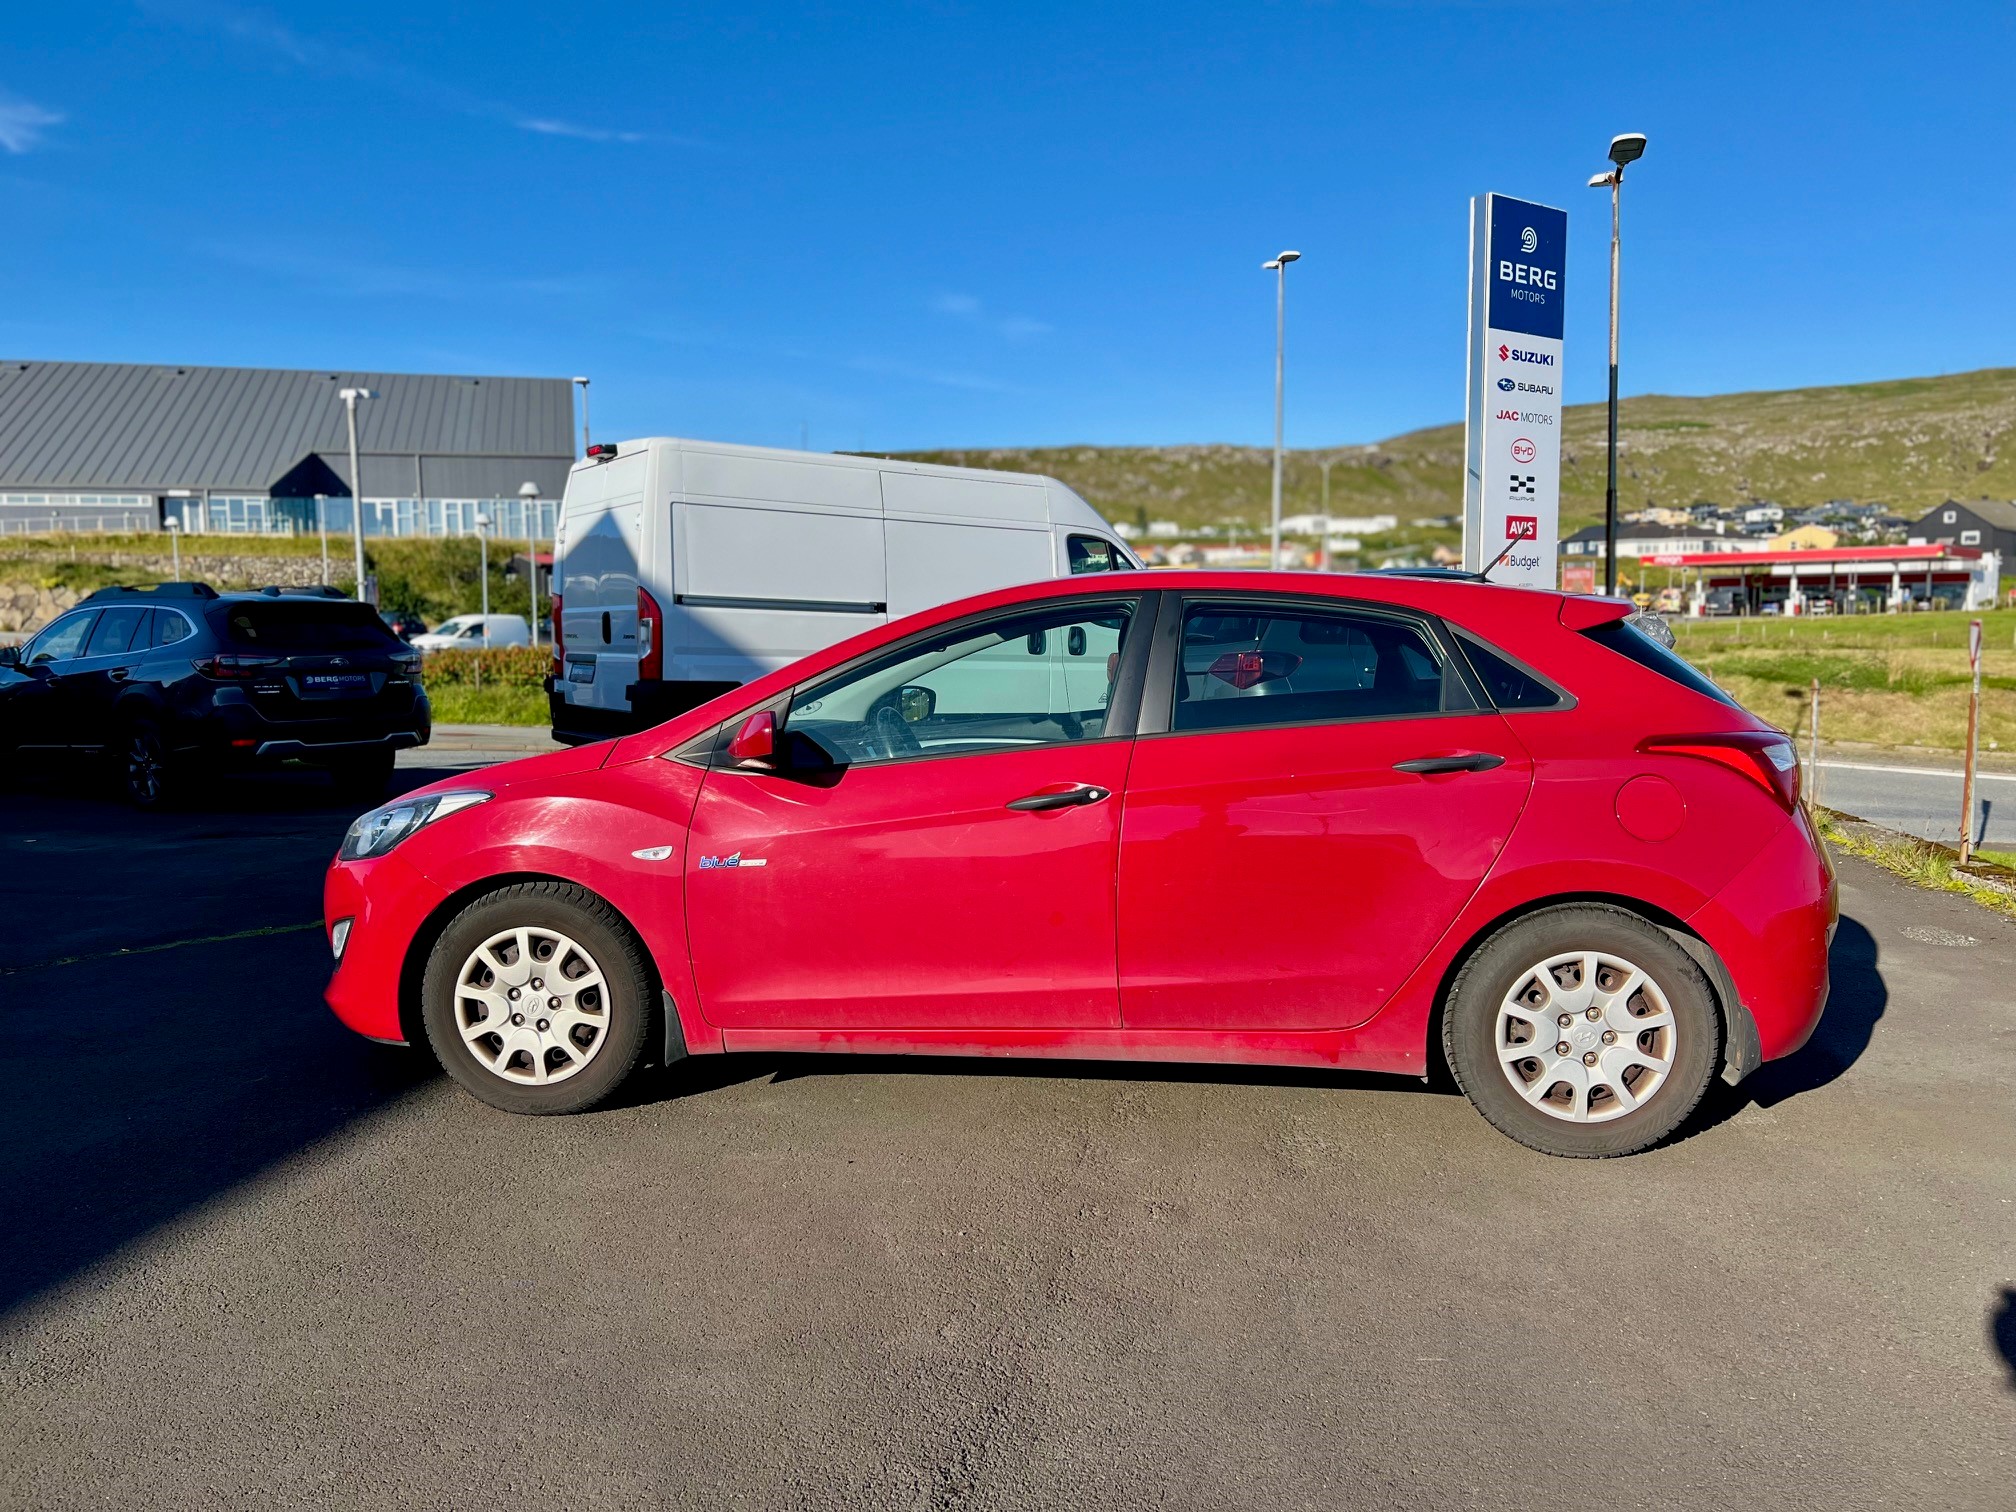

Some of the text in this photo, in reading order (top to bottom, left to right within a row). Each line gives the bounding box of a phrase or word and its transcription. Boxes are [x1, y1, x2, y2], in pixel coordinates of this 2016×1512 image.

[1500, 260, 1556, 290] BERG
[1511, 289, 1545, 304] MOTORS
[1511, 349, 1554, 366] SUZUKI
[1517, 382, 1554, 395] SUBARU
[1496, 410, 1553, 425] JAC MOTORS
[1513, 446, 1534, 456] BYD
[1509, 521, 1533, 535] AVIS
[1510, 555, 1540, 571] Budget
[699, 855, 740, 869] blue
